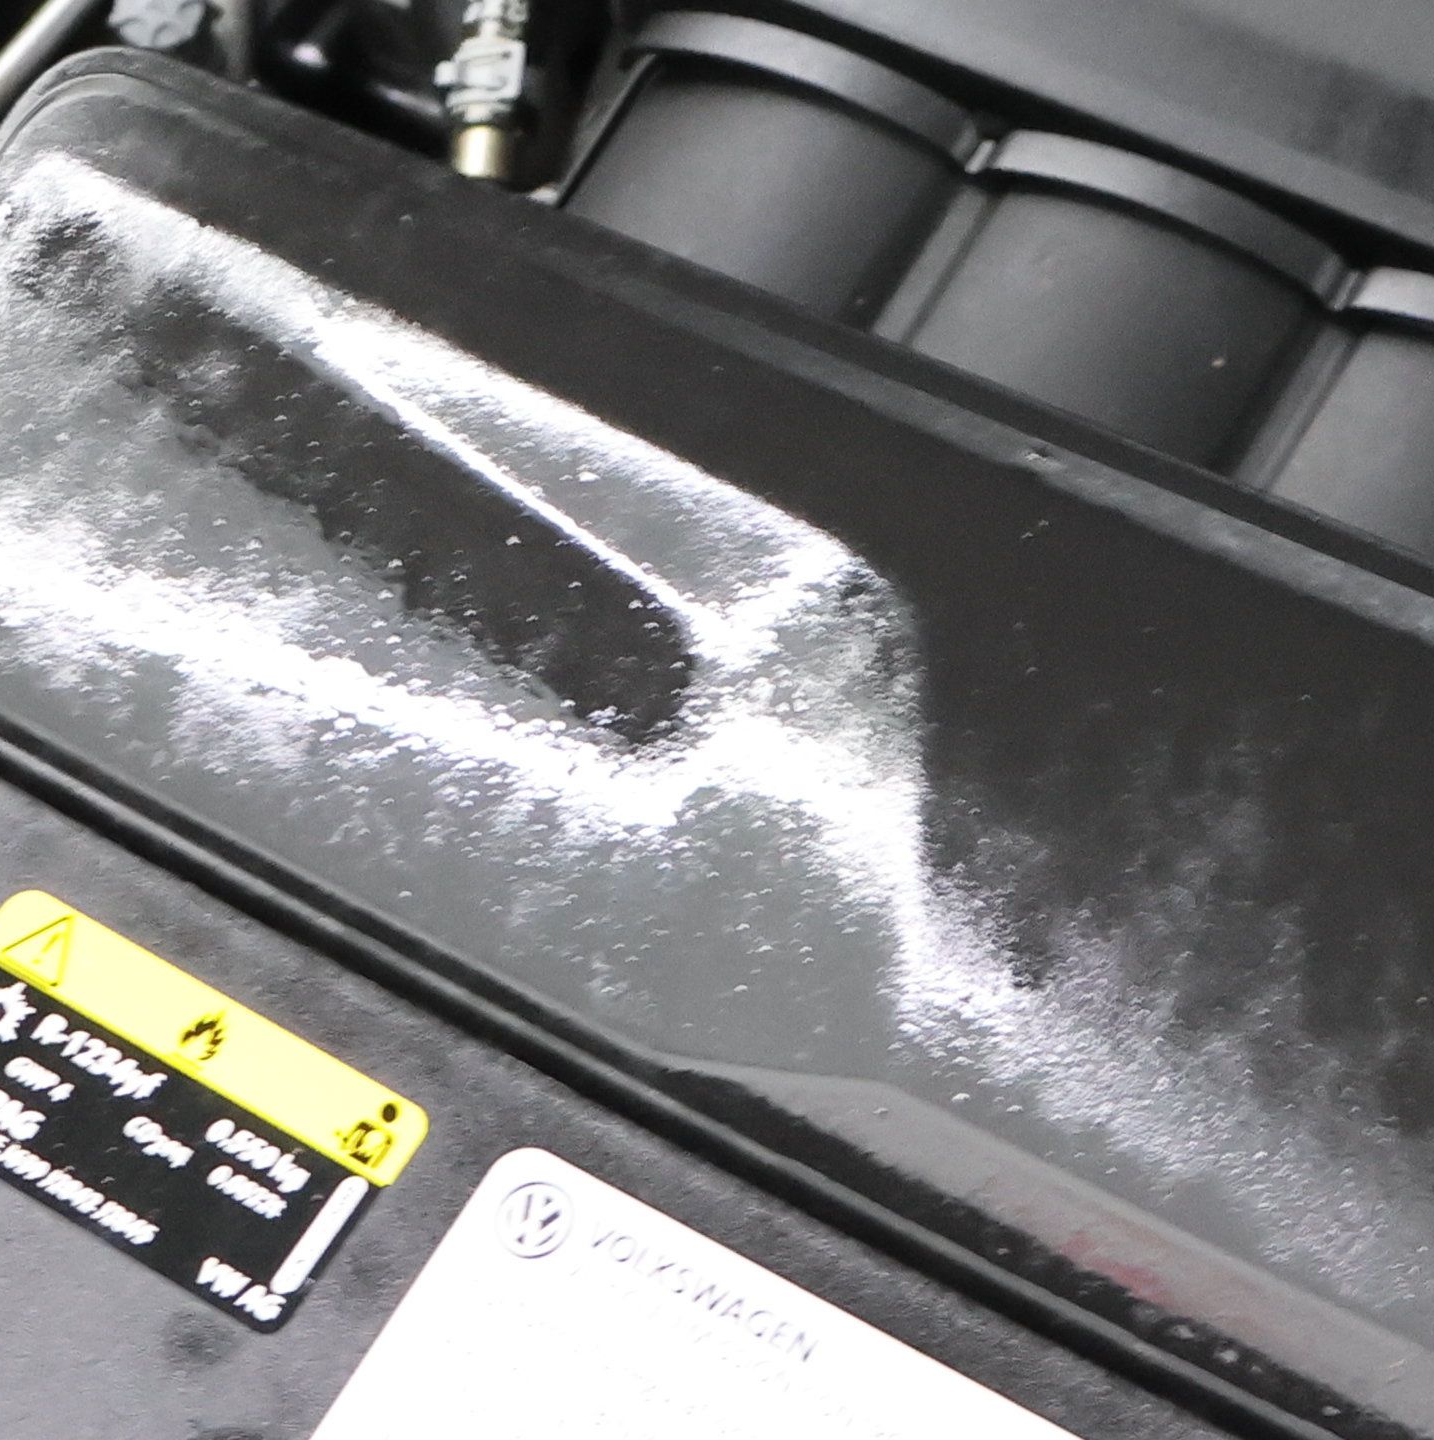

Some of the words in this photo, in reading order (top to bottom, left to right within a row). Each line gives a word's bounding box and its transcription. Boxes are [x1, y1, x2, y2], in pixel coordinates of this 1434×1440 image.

[30, 1013, 167, 1101] R-1234yf
[196, 1256, 252, 1298] VW
[234, 1285, 287, 1321] AG
[590, 1222, 819, 1363] VOLKSWAGEN
